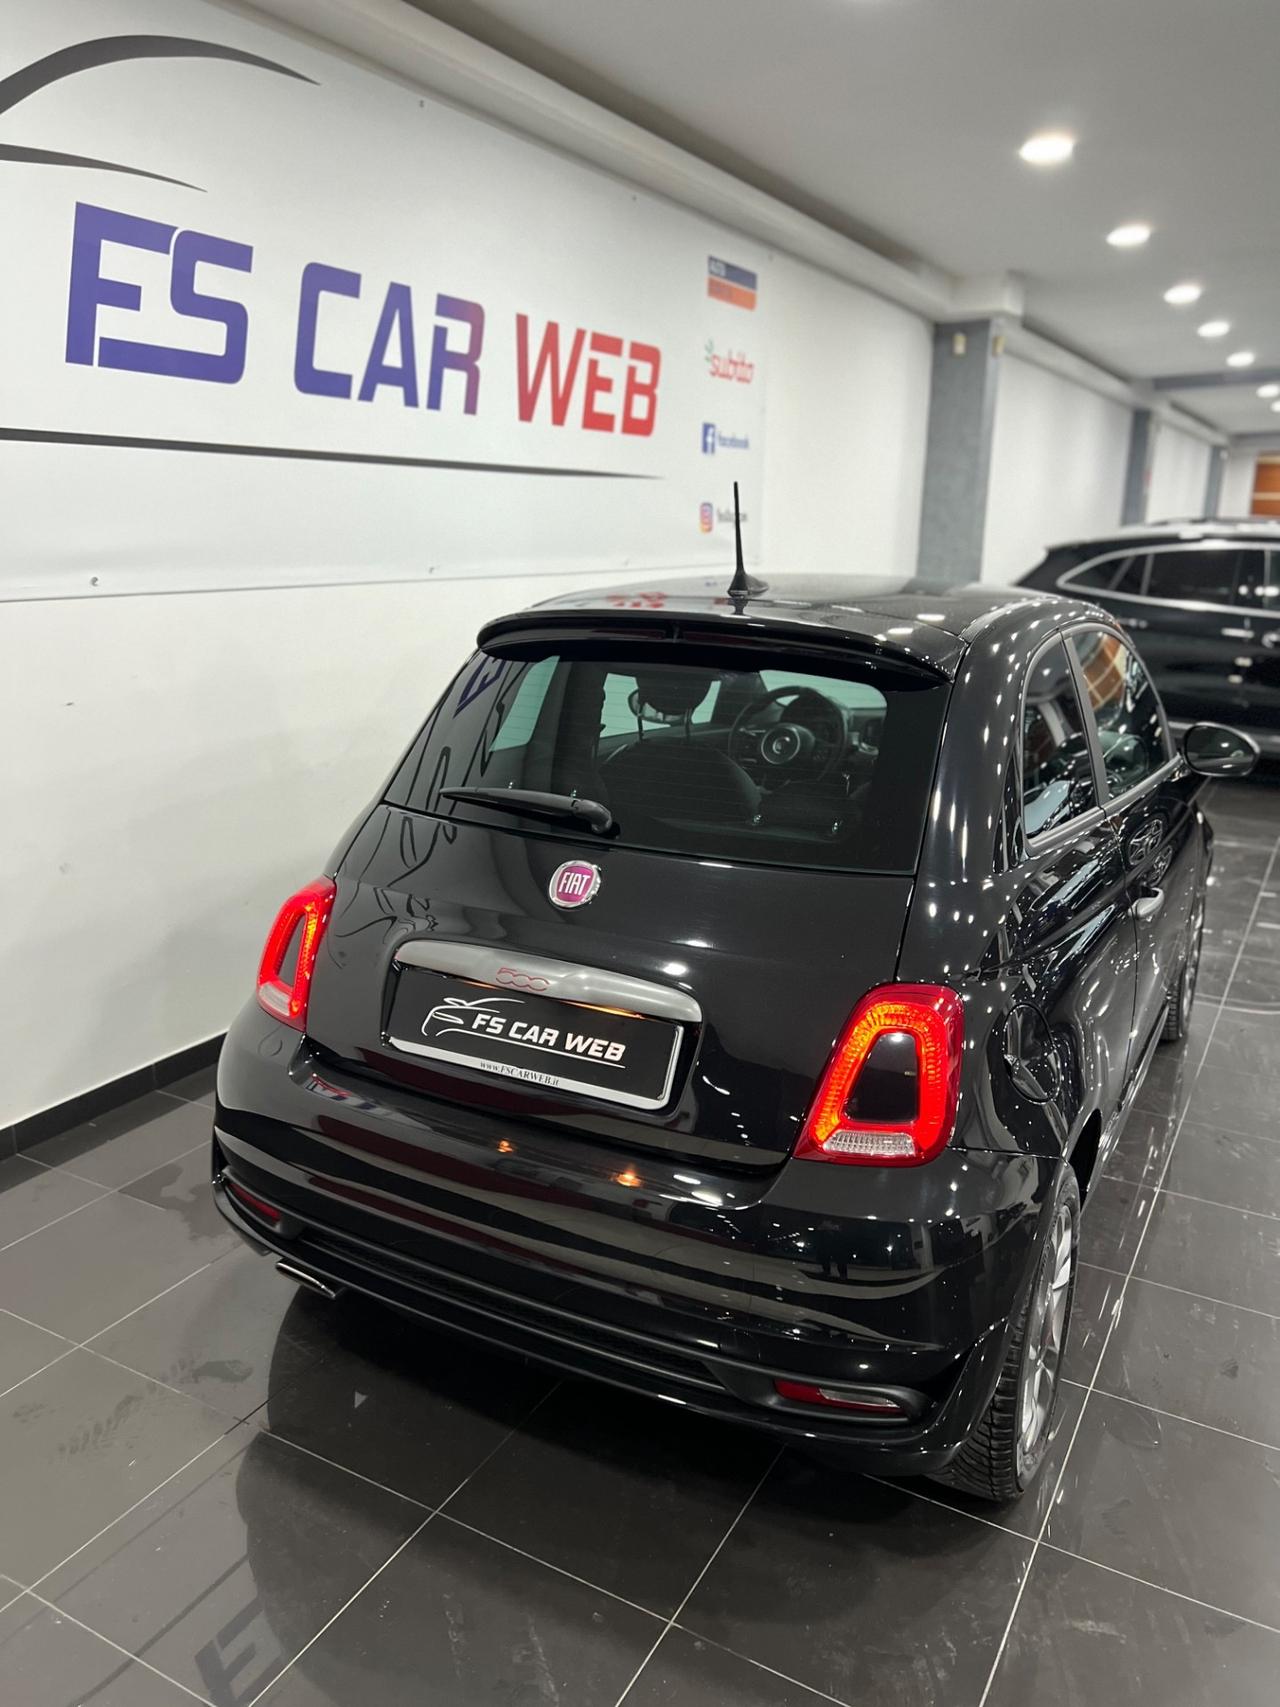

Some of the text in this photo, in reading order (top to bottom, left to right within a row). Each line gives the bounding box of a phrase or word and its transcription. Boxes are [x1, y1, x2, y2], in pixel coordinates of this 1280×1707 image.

[65, 201, 662, 438] FS CAR WEB
[558, 871, 591, 896] FIAT
[495, 967, 551, 992] 500
[471, 1014, 627, 1063] FS CAR WEB
[480, 1061, 560, 1087] www.FSCARWEB.it
